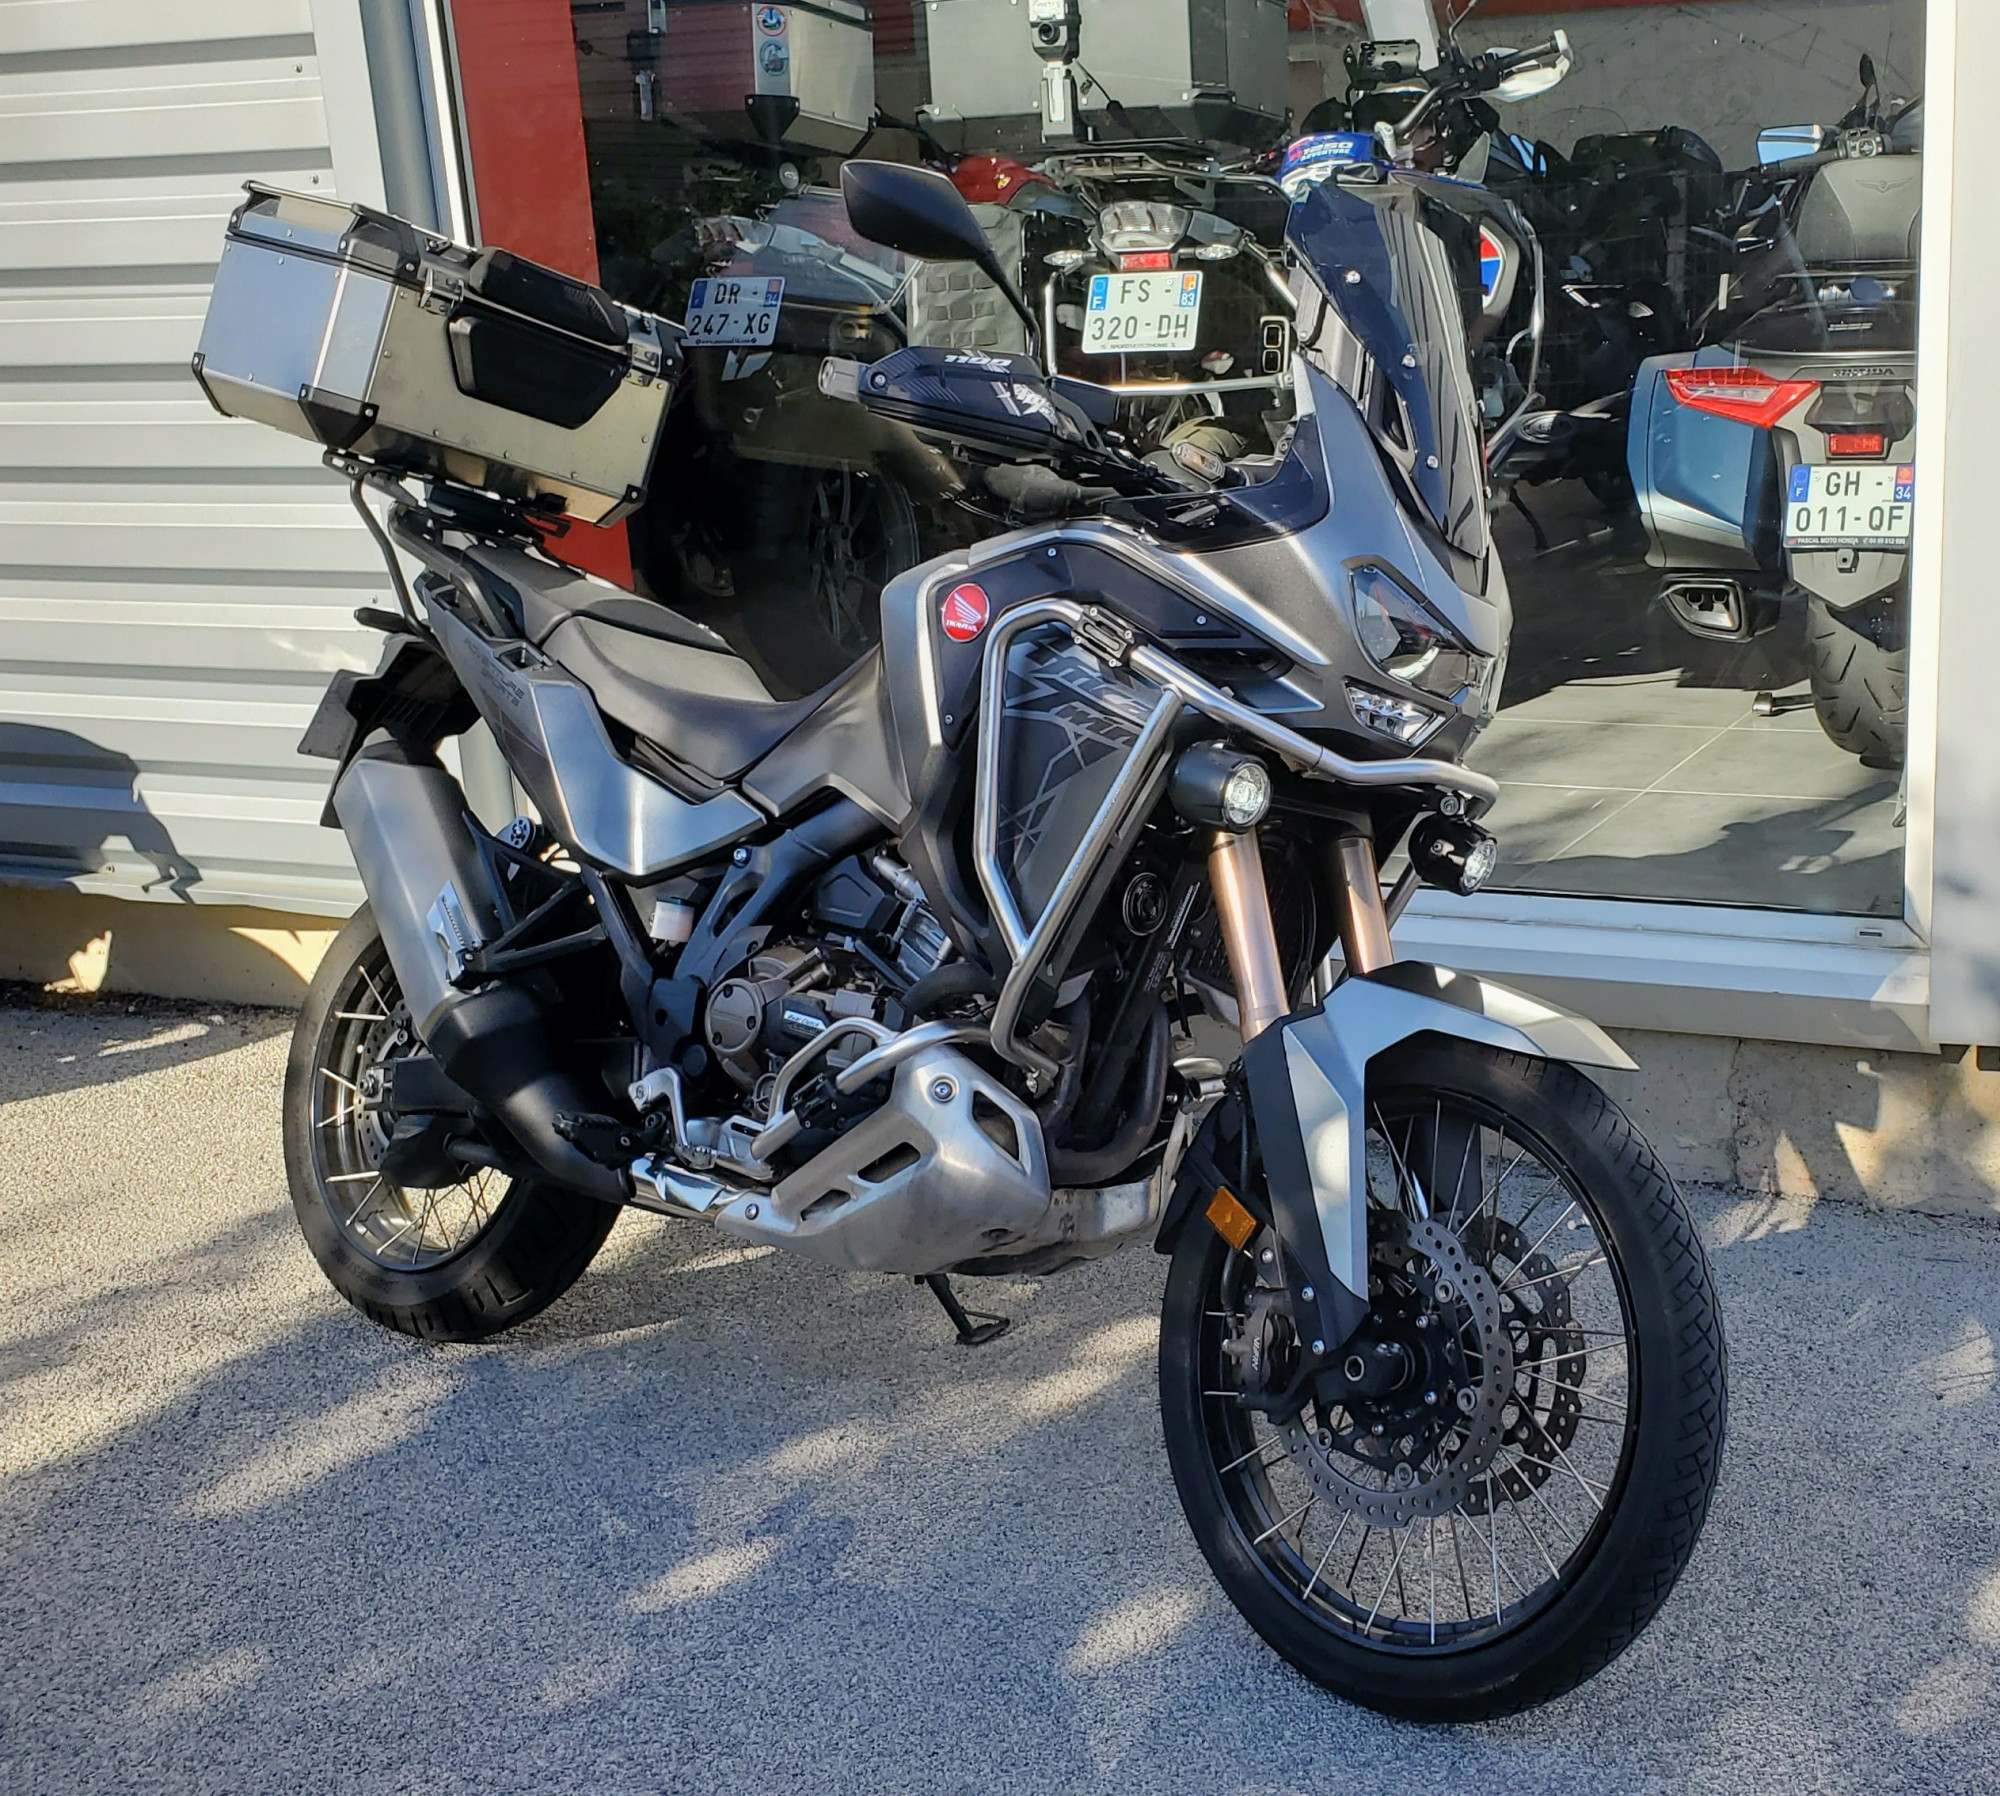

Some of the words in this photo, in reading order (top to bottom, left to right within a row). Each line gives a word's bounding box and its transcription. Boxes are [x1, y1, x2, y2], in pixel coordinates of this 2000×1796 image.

[714, 283, 741, 304] DR
[1092, 296, 1103, 309] F
[1120, 279, 1151, 304] FS
[1180, 292, 1195, 306] 83
[689, 312, 771, 336] 247-XG
[1091, 314, 1188, 340] 320-DH
[1825, 471, 1861, 496] GH
[1895, 486, 1911, 499] 34
[1796, 506, 1905, 532] 011-QF
[946, 620, 978, 632] HONDA
